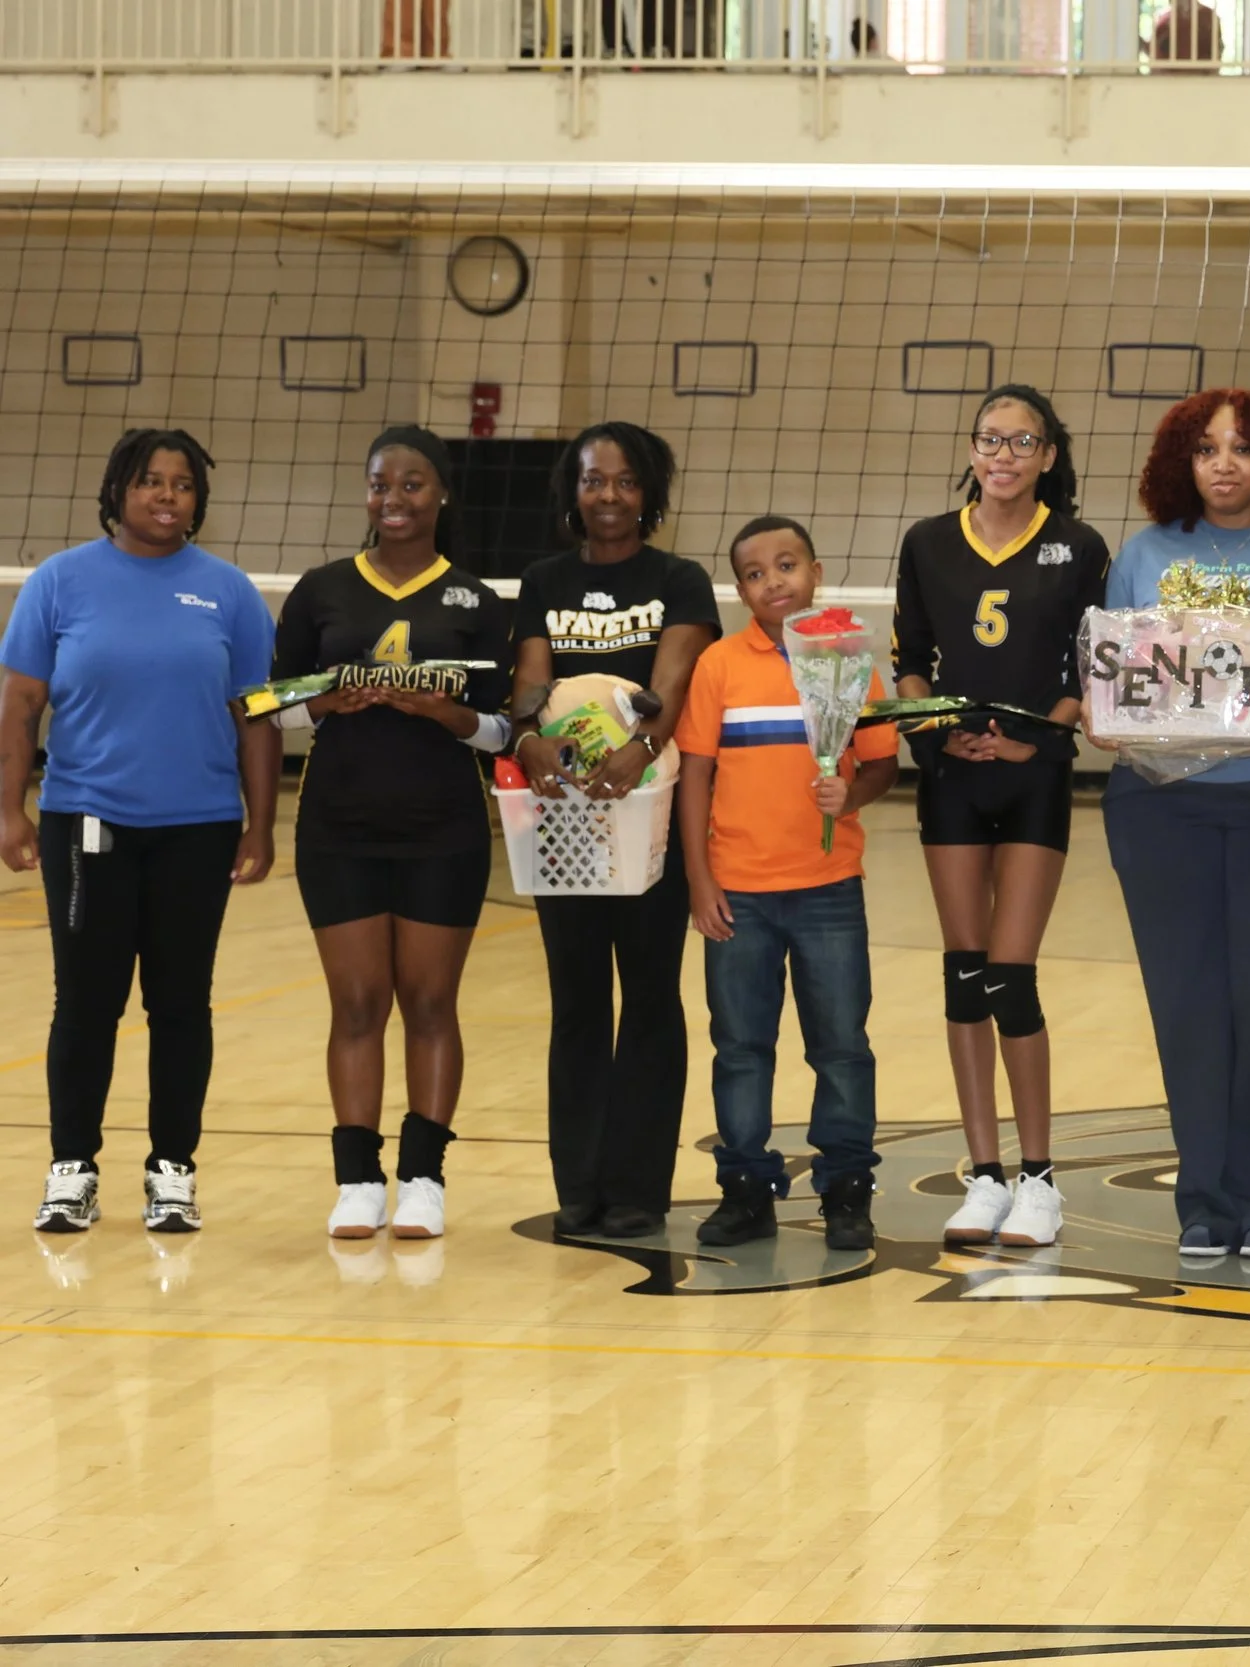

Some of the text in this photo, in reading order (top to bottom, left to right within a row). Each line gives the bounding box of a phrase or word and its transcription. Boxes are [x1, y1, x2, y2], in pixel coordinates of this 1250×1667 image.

[1193, 563, 1233, 574] Farm
[545, 599, 665, 639] AFAYETTE
[973, 589, 1010, 648] 5
[372, 620, 412, 666] 4
[551, 632, 651, 650] ULLDOGS
